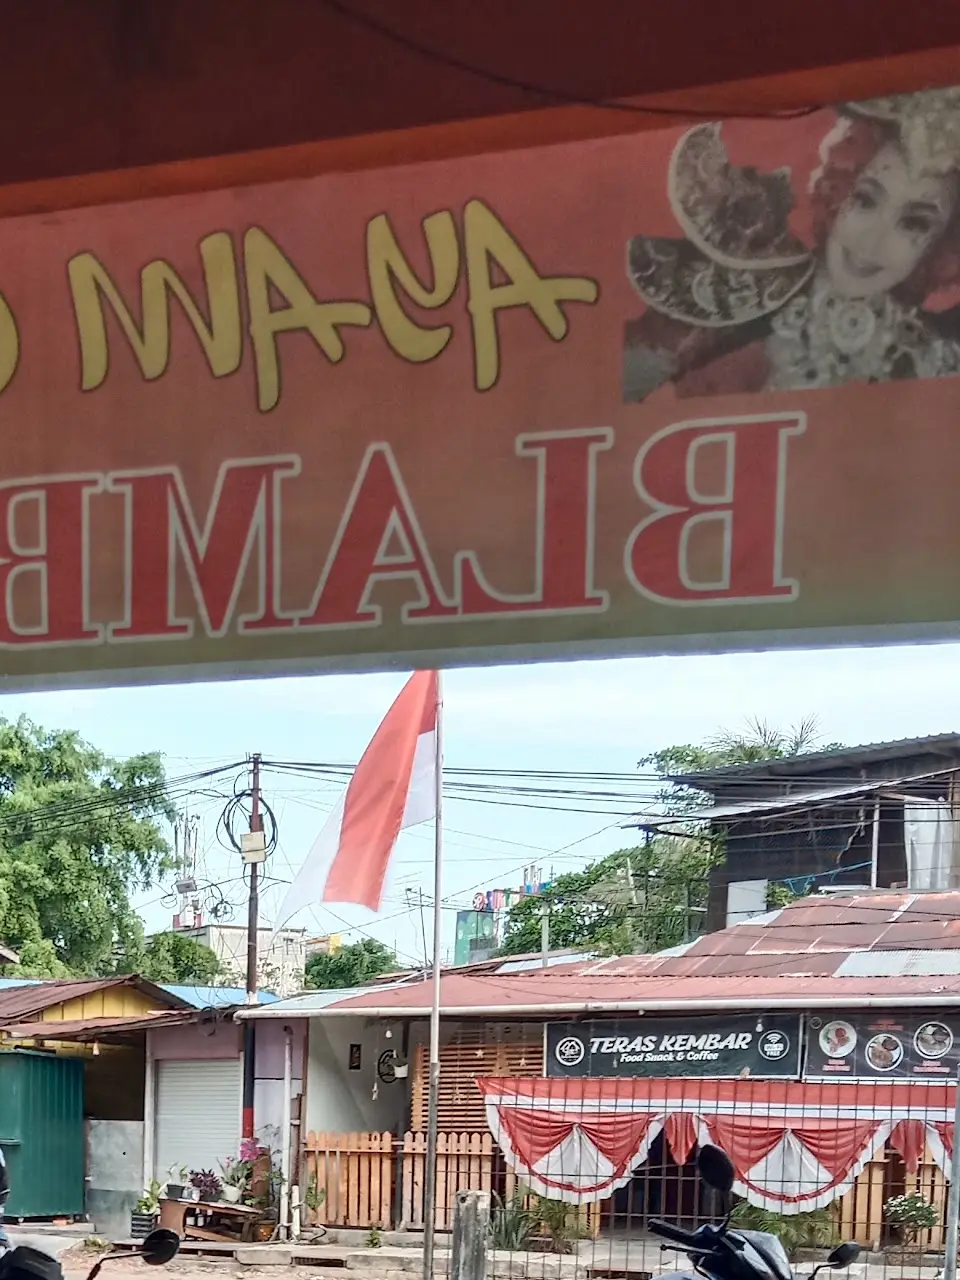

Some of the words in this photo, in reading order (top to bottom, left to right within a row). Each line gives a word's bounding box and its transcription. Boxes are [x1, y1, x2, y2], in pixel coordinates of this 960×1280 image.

[590, 1035, 658, 1054] TERAS
[659, 1032, 753, 1052] KEMBAR
[620, 1052, 645, 1063] Food
[644, 1051, 675, 1062] Snack
[675, 1052, 686, 1061] &
[686, 1050, 719, 1061] Coffee
